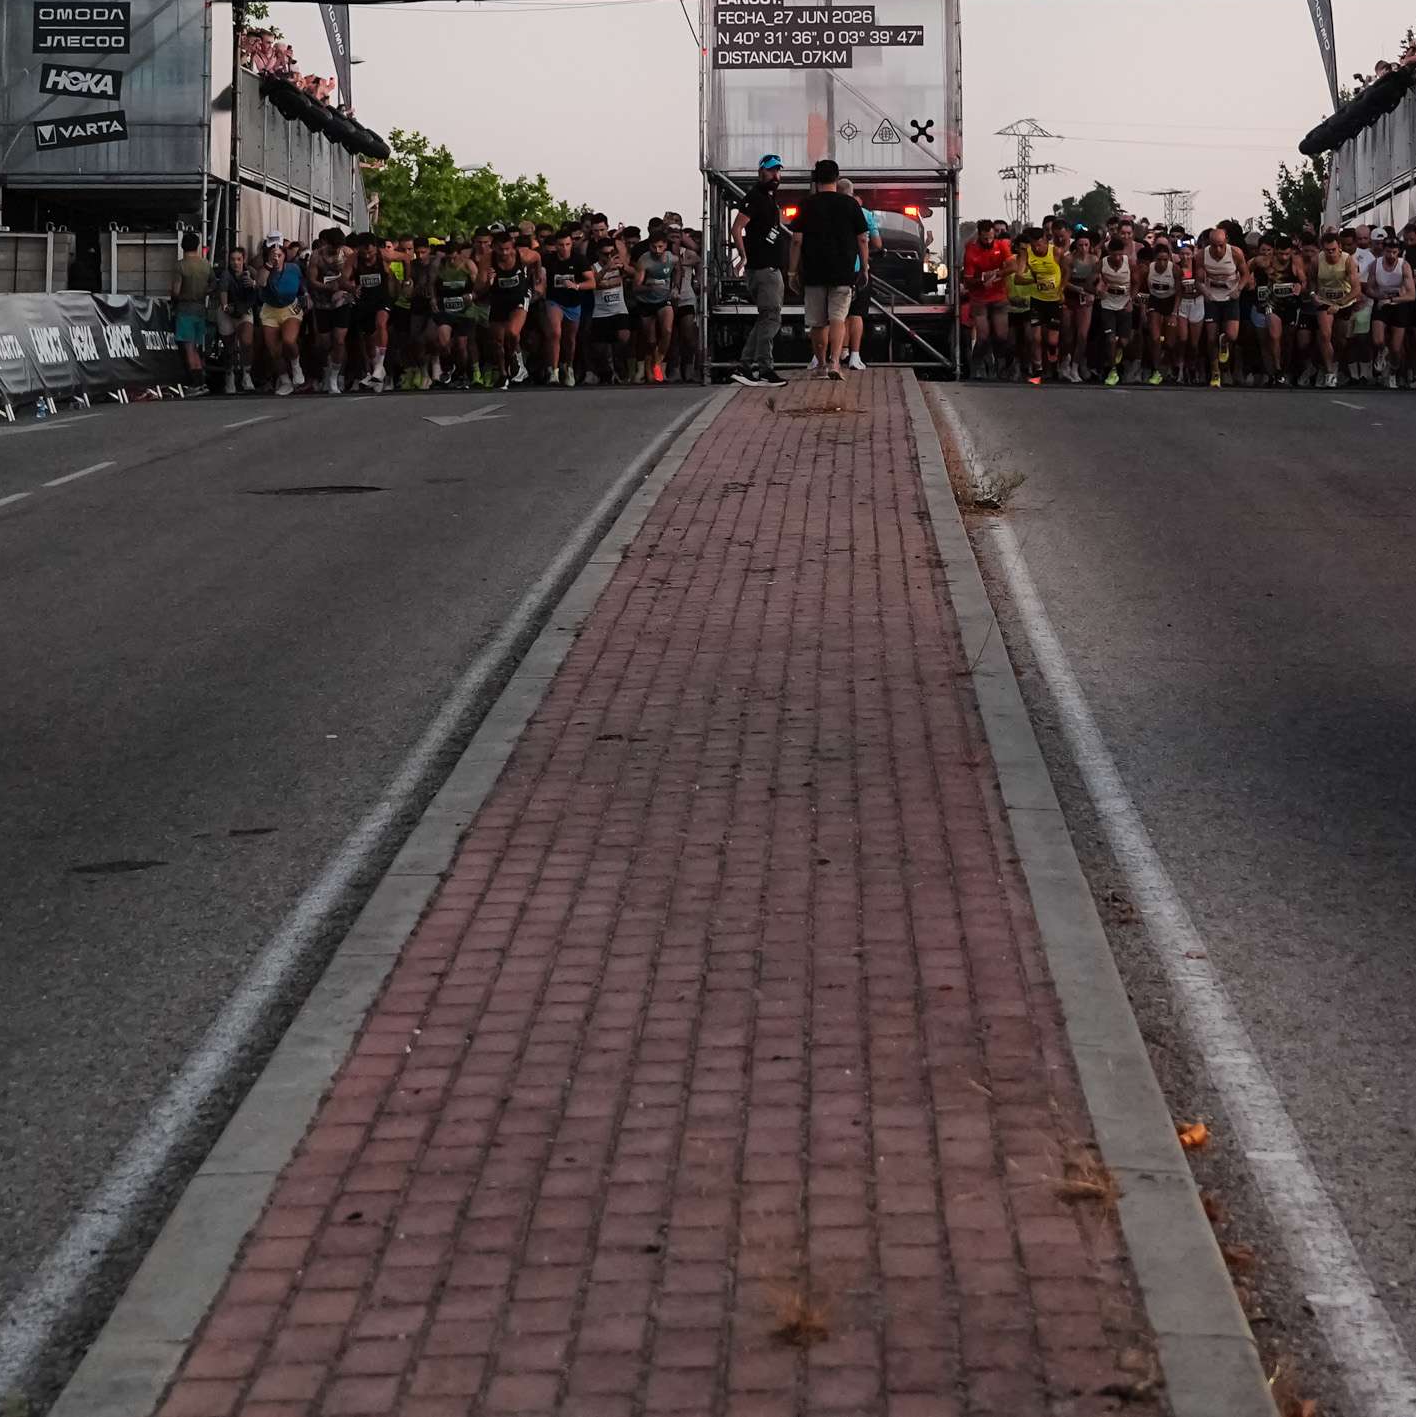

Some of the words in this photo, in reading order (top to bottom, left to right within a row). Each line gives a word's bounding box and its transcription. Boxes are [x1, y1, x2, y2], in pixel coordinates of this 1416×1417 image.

[39, 8, 125, 20] OMODA
[797, 10, 829, 24] JUN
[832, 10, 873, 24] 2026
[39, 35, 125, 47] JAECOO
[717, 31, 730, 45] N
[717, 50, 847, 66] DISTANCIA_07KM
[45, 69, 114, 95] HOKA
[59, 119, 124, 139] VARTA
